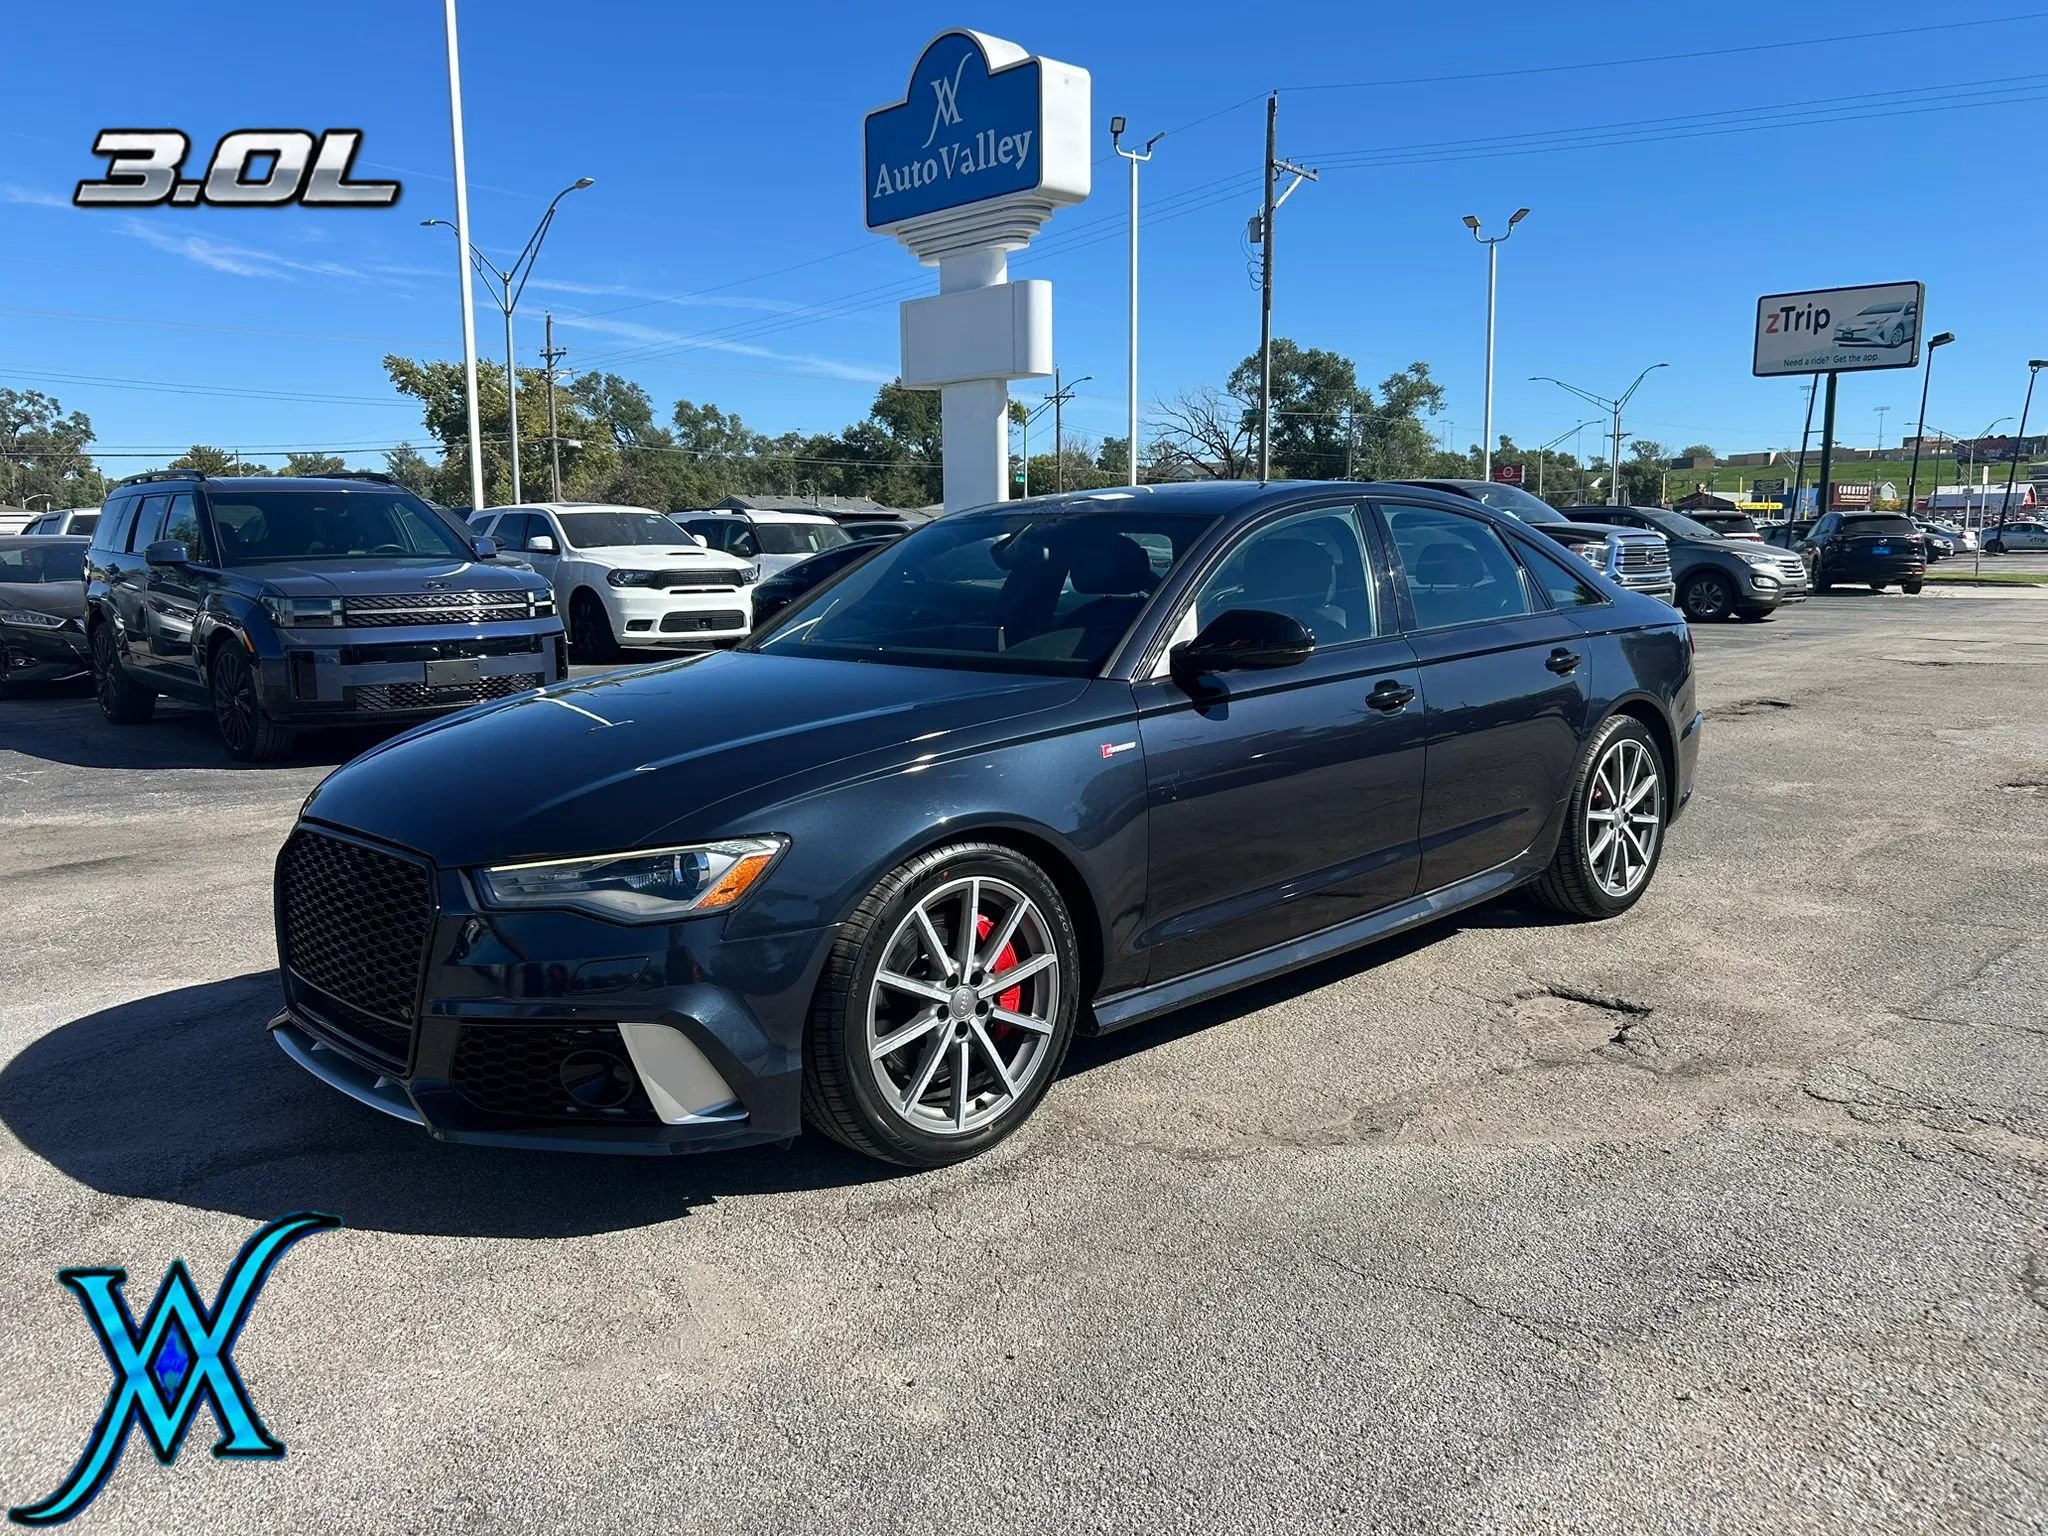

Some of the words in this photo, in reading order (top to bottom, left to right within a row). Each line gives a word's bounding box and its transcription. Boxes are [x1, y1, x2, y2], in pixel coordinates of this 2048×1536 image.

[1765, 302, 1831, 335] zTrip
[1783, 357, 1803, 367] Need
[1810, 356, 1830, 365] ride?
[1833, 354, 1847, 363] Get
[1848, 353, 1862, 362] the
[1862, 353, 1880, 364] app.
